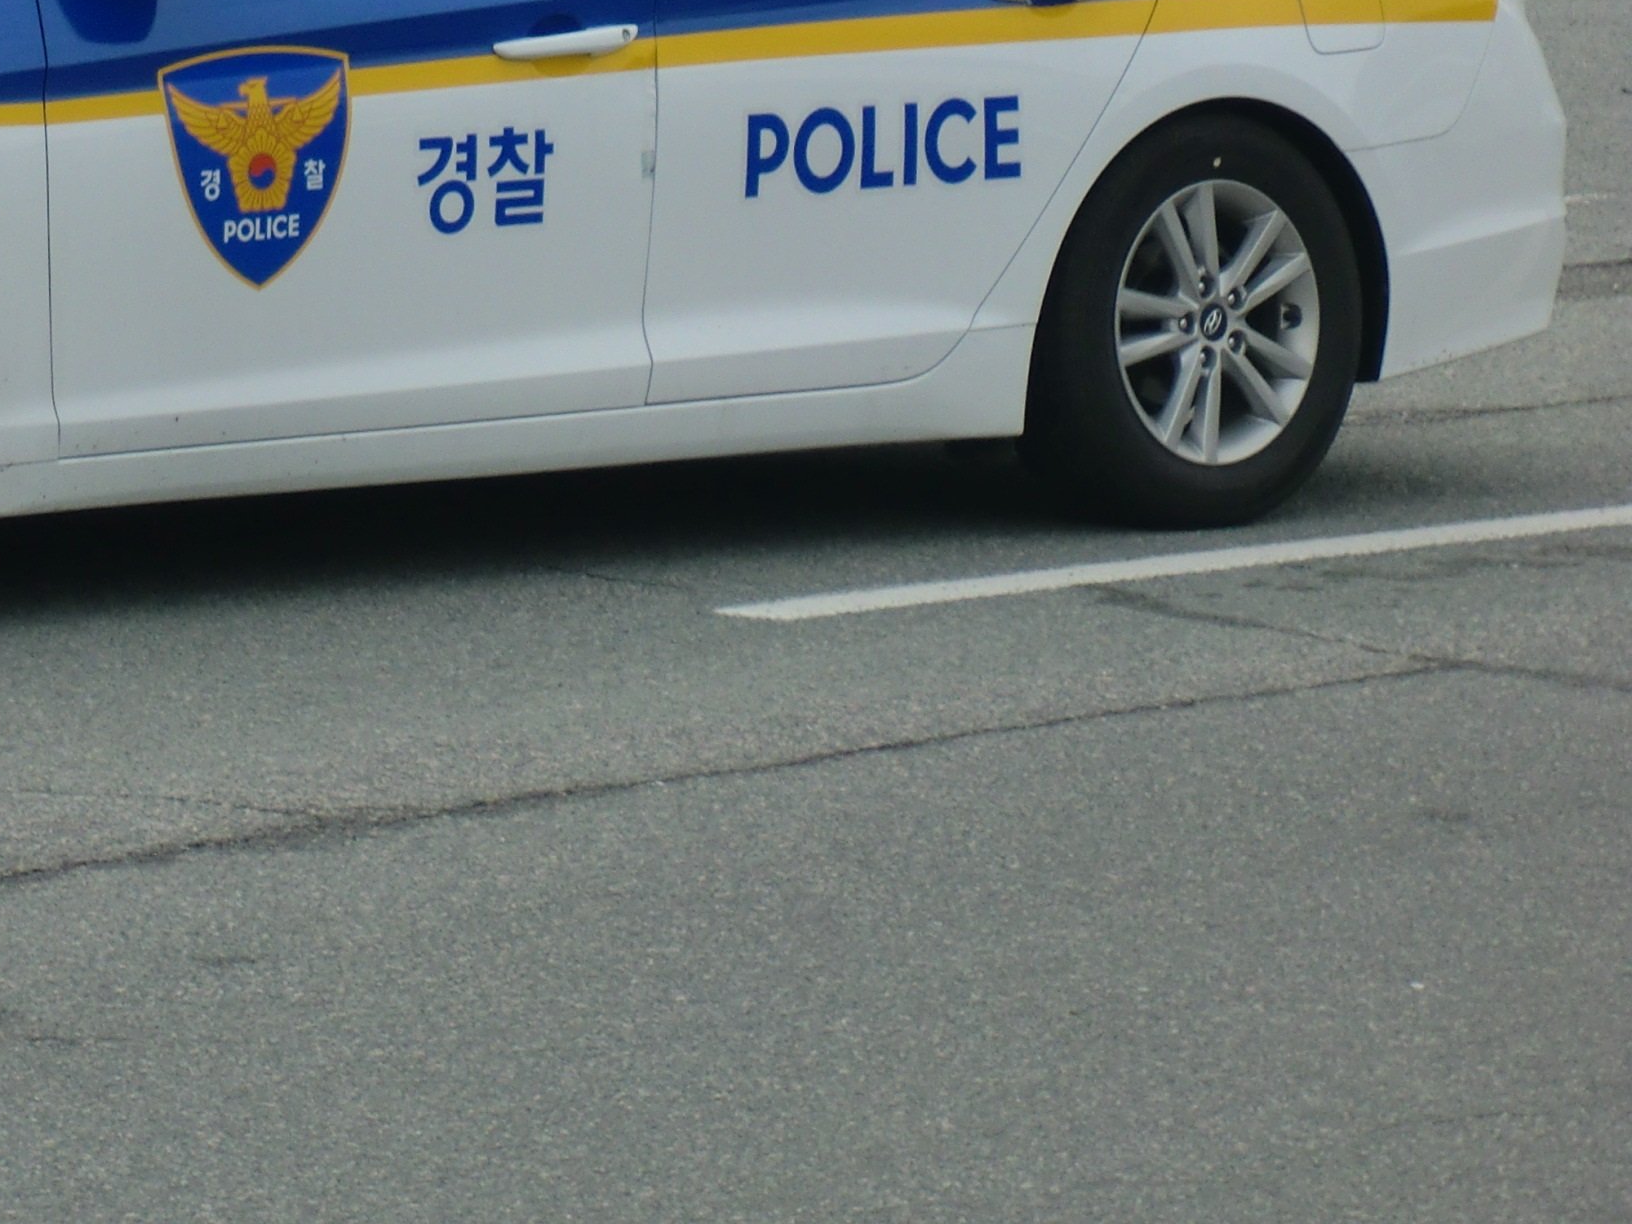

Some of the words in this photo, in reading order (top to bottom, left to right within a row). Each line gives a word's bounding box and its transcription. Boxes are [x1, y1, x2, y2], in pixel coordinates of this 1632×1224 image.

[743, 95, 1022, 199] POLICE
[200, 167, 222, 202] 경
[303, 158, 326, 191] 찰
[416, 126, 554, 235] 경찰
[223, 213, 301, 244] POLICE
